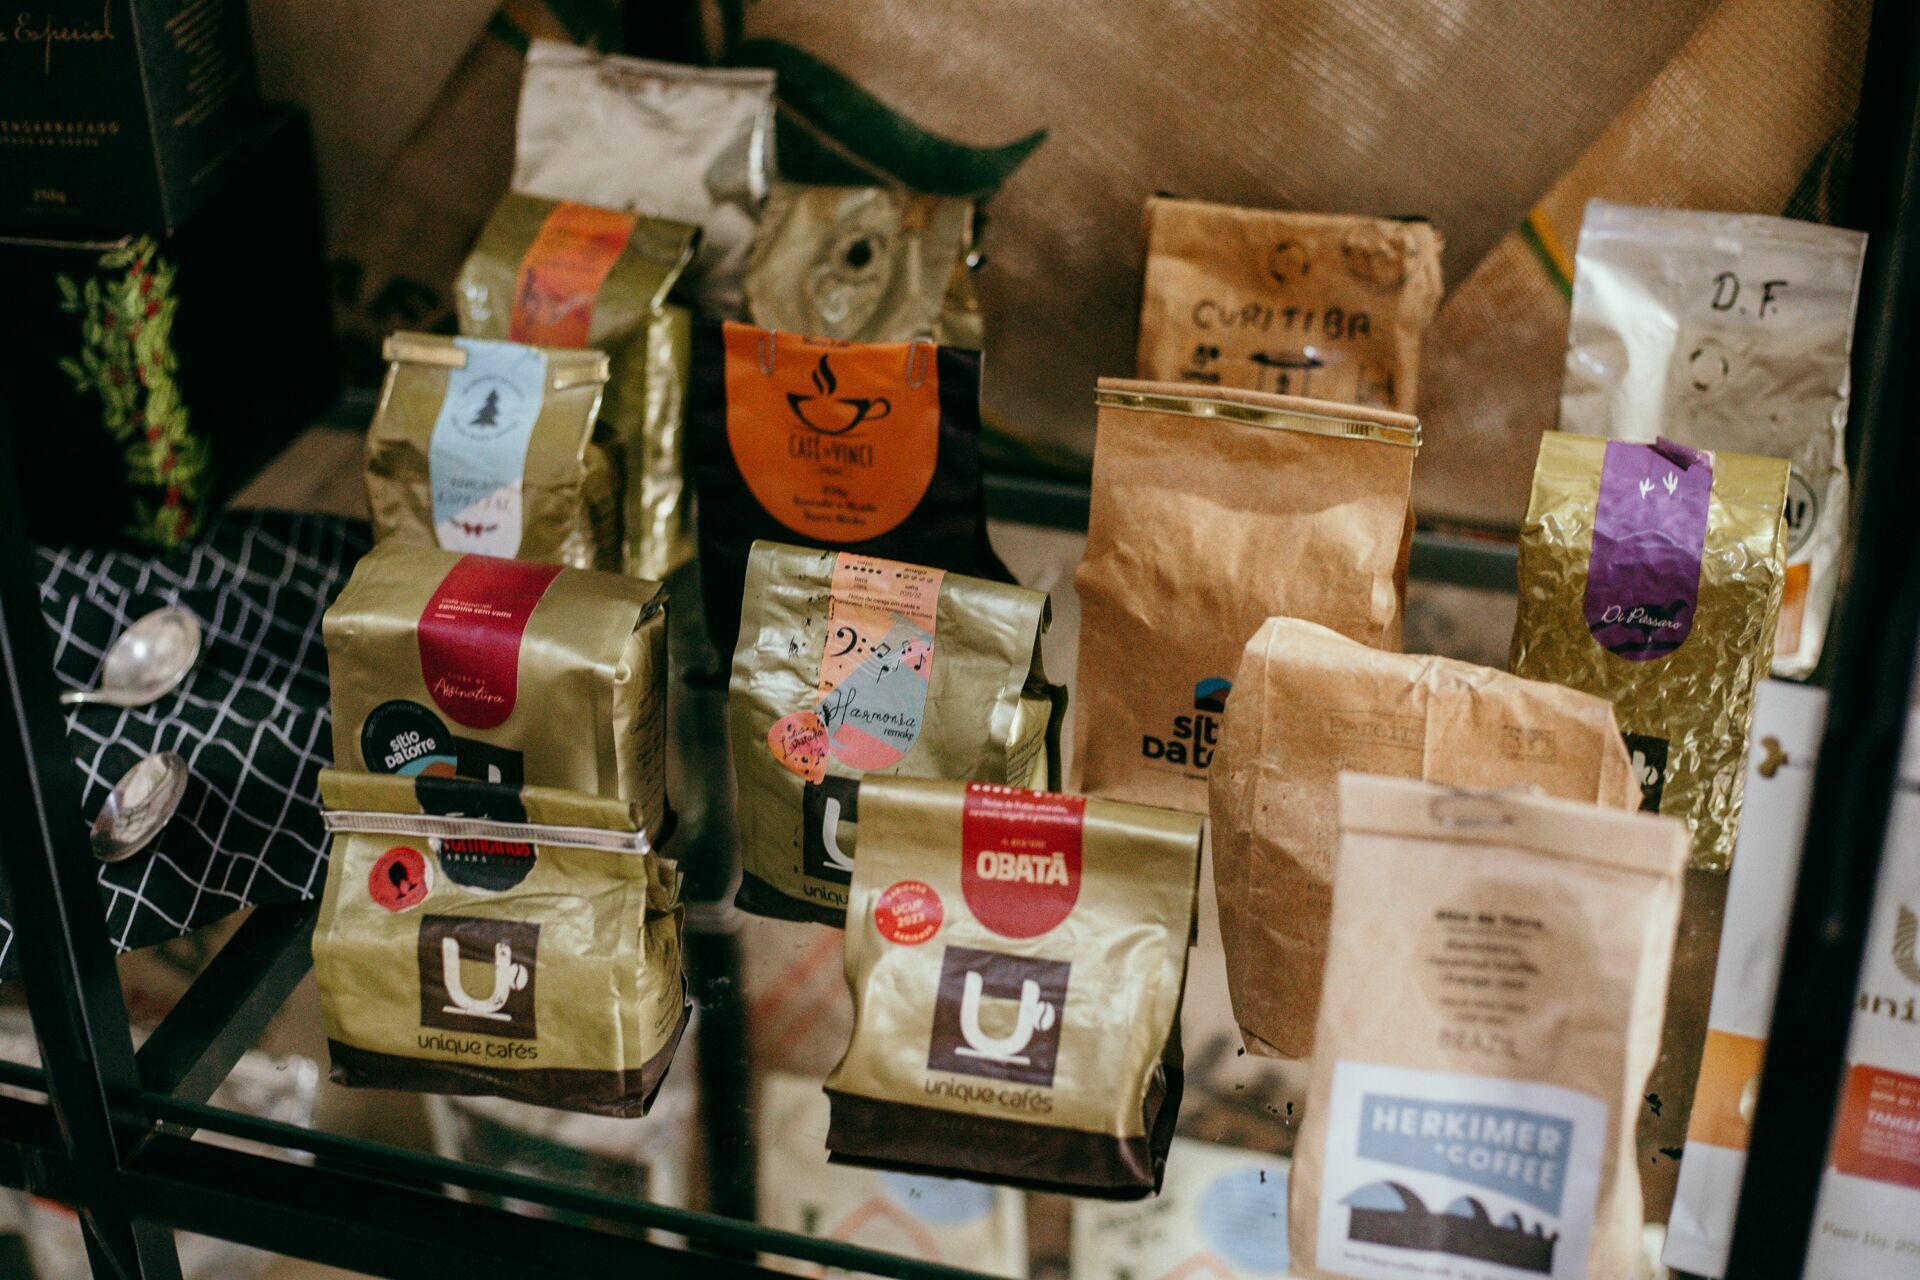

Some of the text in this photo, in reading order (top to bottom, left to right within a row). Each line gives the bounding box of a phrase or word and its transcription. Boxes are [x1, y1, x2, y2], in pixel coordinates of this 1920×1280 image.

[1192, 299, 1373, 341] CURITIBA
[883, 726, 915, 742] remake
[1172, 714, 1219, 745] sit
[802, 884, 850, 904] uniqu
[417, 1033, 538, 1061] unique cafés
[924, 1078, 1054, 1114] unique cafés
[1371, 1104, 1562, 1156] HERKIMER
[1446, 1146, 1558, 1192] COFFEE
